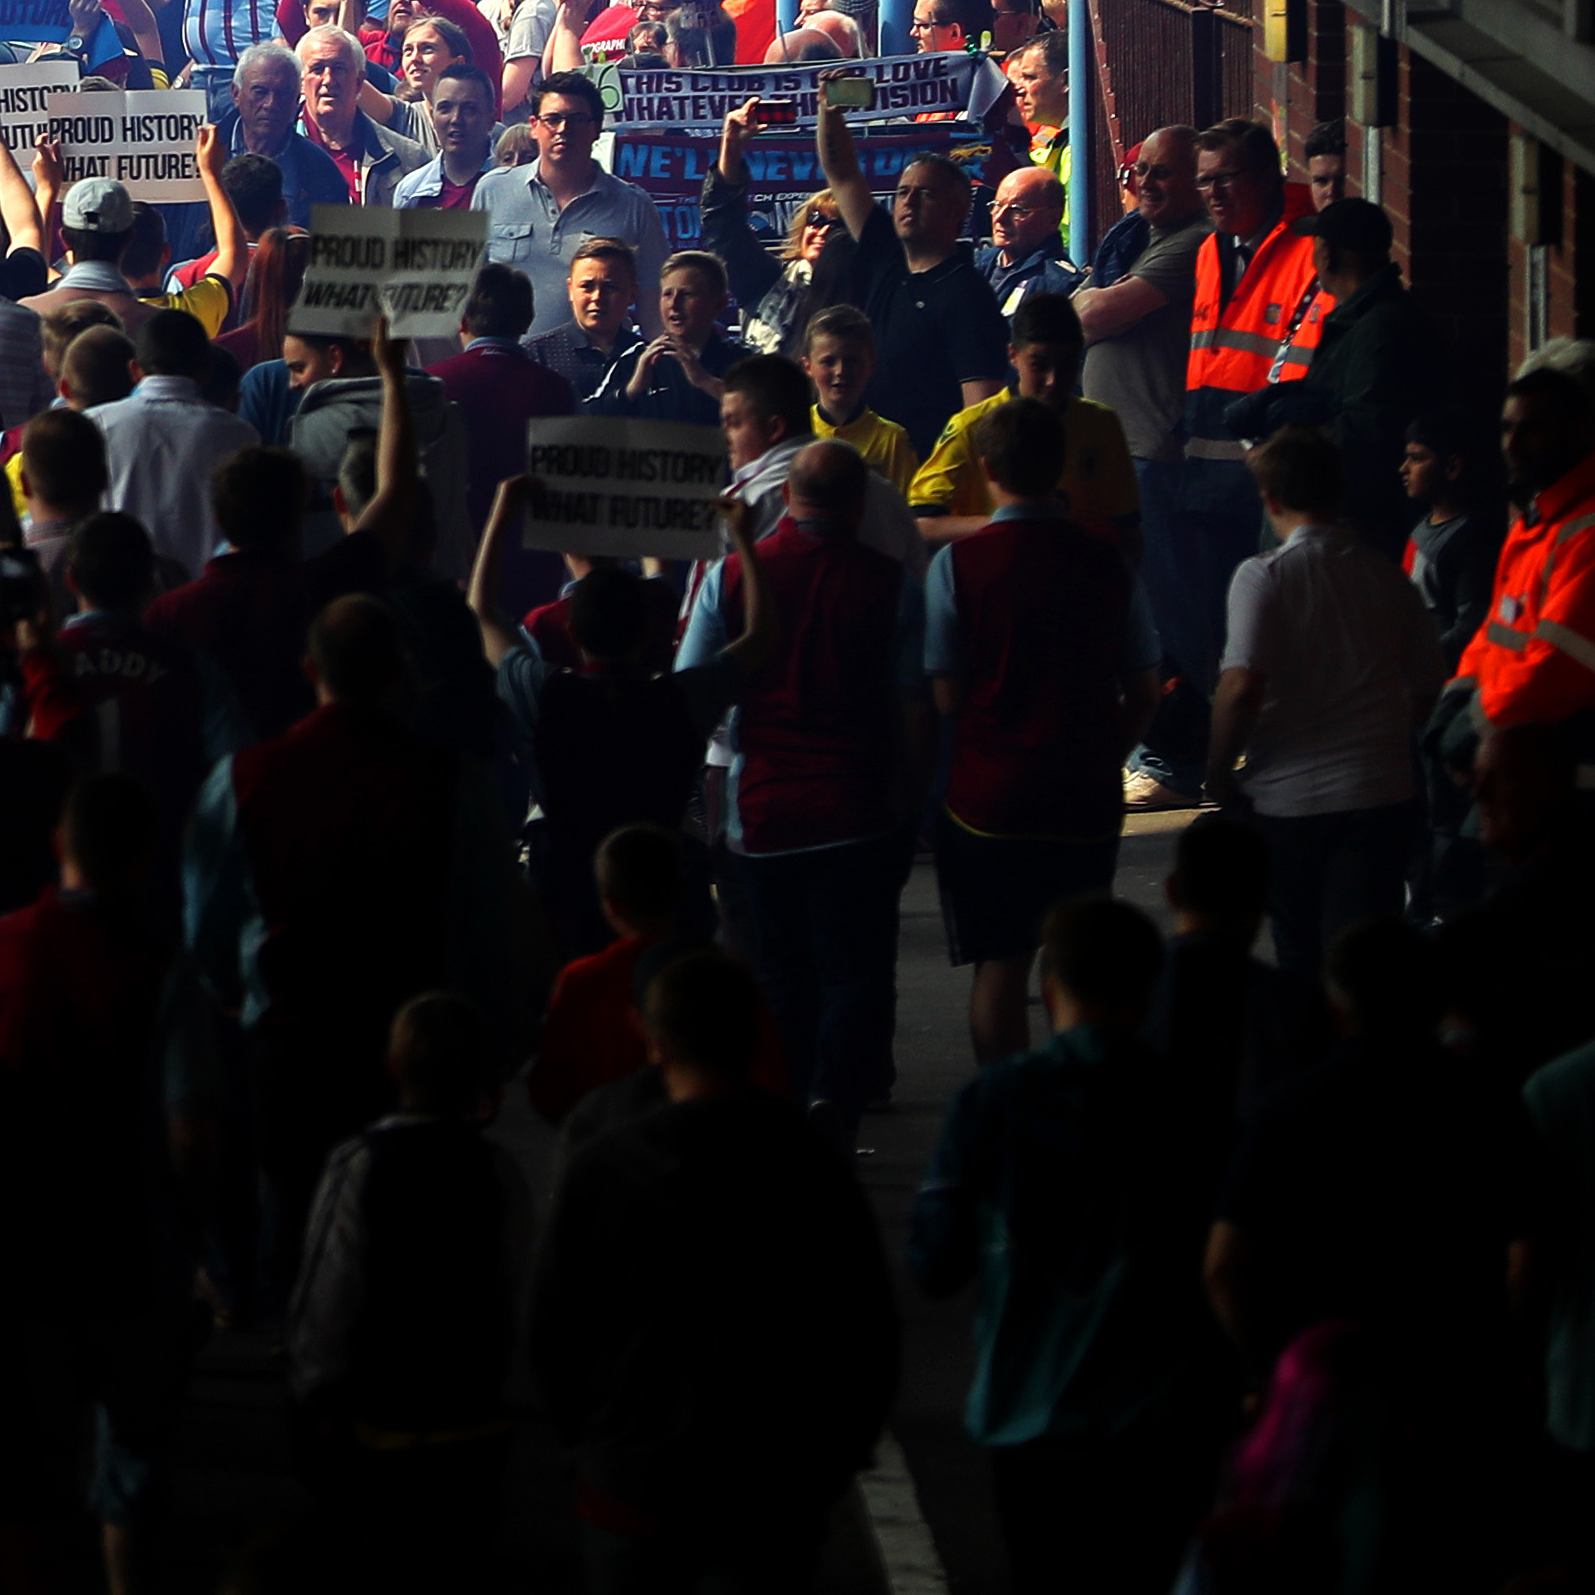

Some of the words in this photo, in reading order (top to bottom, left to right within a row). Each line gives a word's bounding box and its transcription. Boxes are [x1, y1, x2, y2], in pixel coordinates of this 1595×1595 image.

[622, 73, 688, 94] THIS
[695, 72, 768, 93] CLUB
[773, 73, 798, 92] IS
[876, 55, 949, 84] LOVE
[49, 115, 114, 145] PROUD
[122, 113, 206, 143] HISTORY
[313, 235, 386, 271] PROUD
[394, 236, 485, 270] HISTORY
[305, 282, 369, 308] WHAT
[530, 444, 609, 479] PROUD
[615, 447, 726, 484] HISTORY
[73, 646, 171, 686] ADDY
